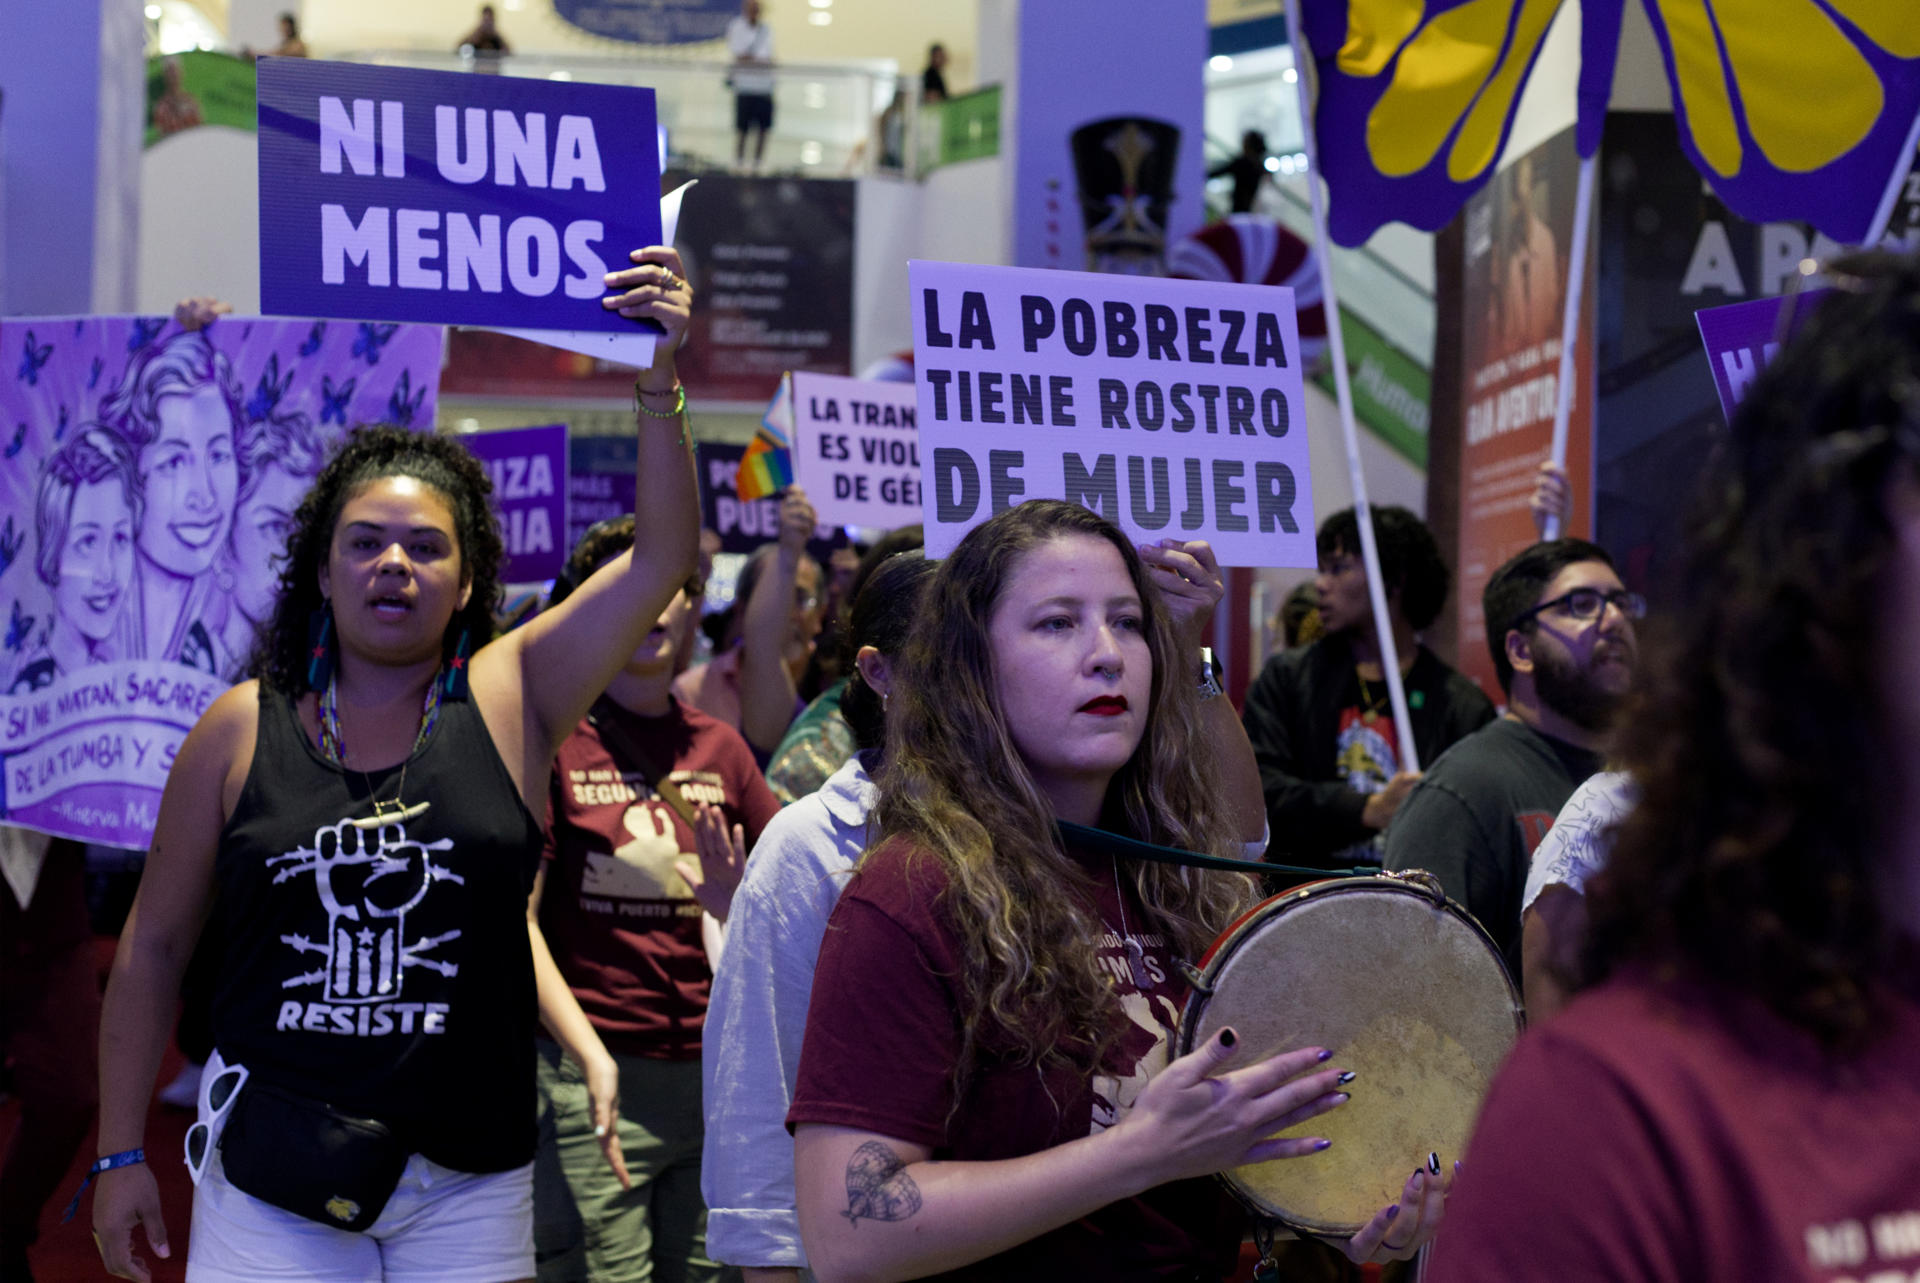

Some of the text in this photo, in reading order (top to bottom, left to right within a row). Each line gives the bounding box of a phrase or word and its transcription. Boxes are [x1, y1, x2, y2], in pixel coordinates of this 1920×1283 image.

[319, 96, 606, 192] NI UNA
[321, 204, 608, 299] MENOS
[923, 288, 1288, 368] LA POBREZA
[810, 398, 840, 422] LA
[926, 368, 1077, 427] TIENE
[1099, 378, 1290, 437] ROSTRO
[820, 434, 849, 461] ES
[484, 454, 554, 501] IZA
[834, 474, 923, 505] DE GÉ
[933, 447, 1300, 533] DE MUJER
[6, 706, 27, 740] SI
[15, 767, 33, 795] DE
[38, 757, 55, 787] LA
[58, 734, 124, 775] TUMBA
[132, 736, 151, 768] Y
[276, 1001, 450, 1037] RESISTE
